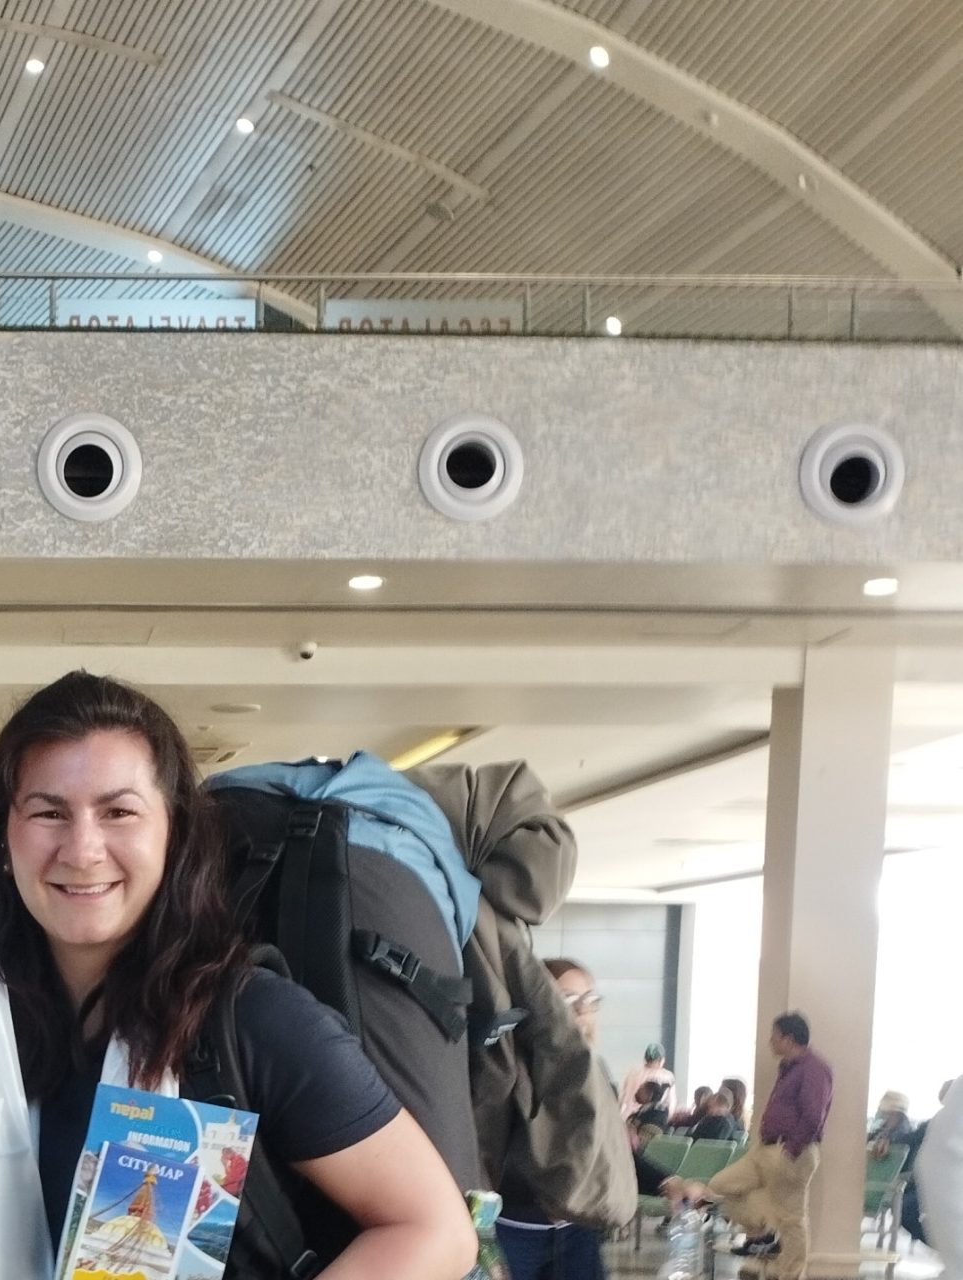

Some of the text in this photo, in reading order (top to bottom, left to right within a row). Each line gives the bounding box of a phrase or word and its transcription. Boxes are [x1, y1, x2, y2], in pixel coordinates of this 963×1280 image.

[111, 1102, 155, 1121] nepal
[126, 1130, 192, 1153] INFORMATION
[118, 1154, 184, 1182] CITY MAP
